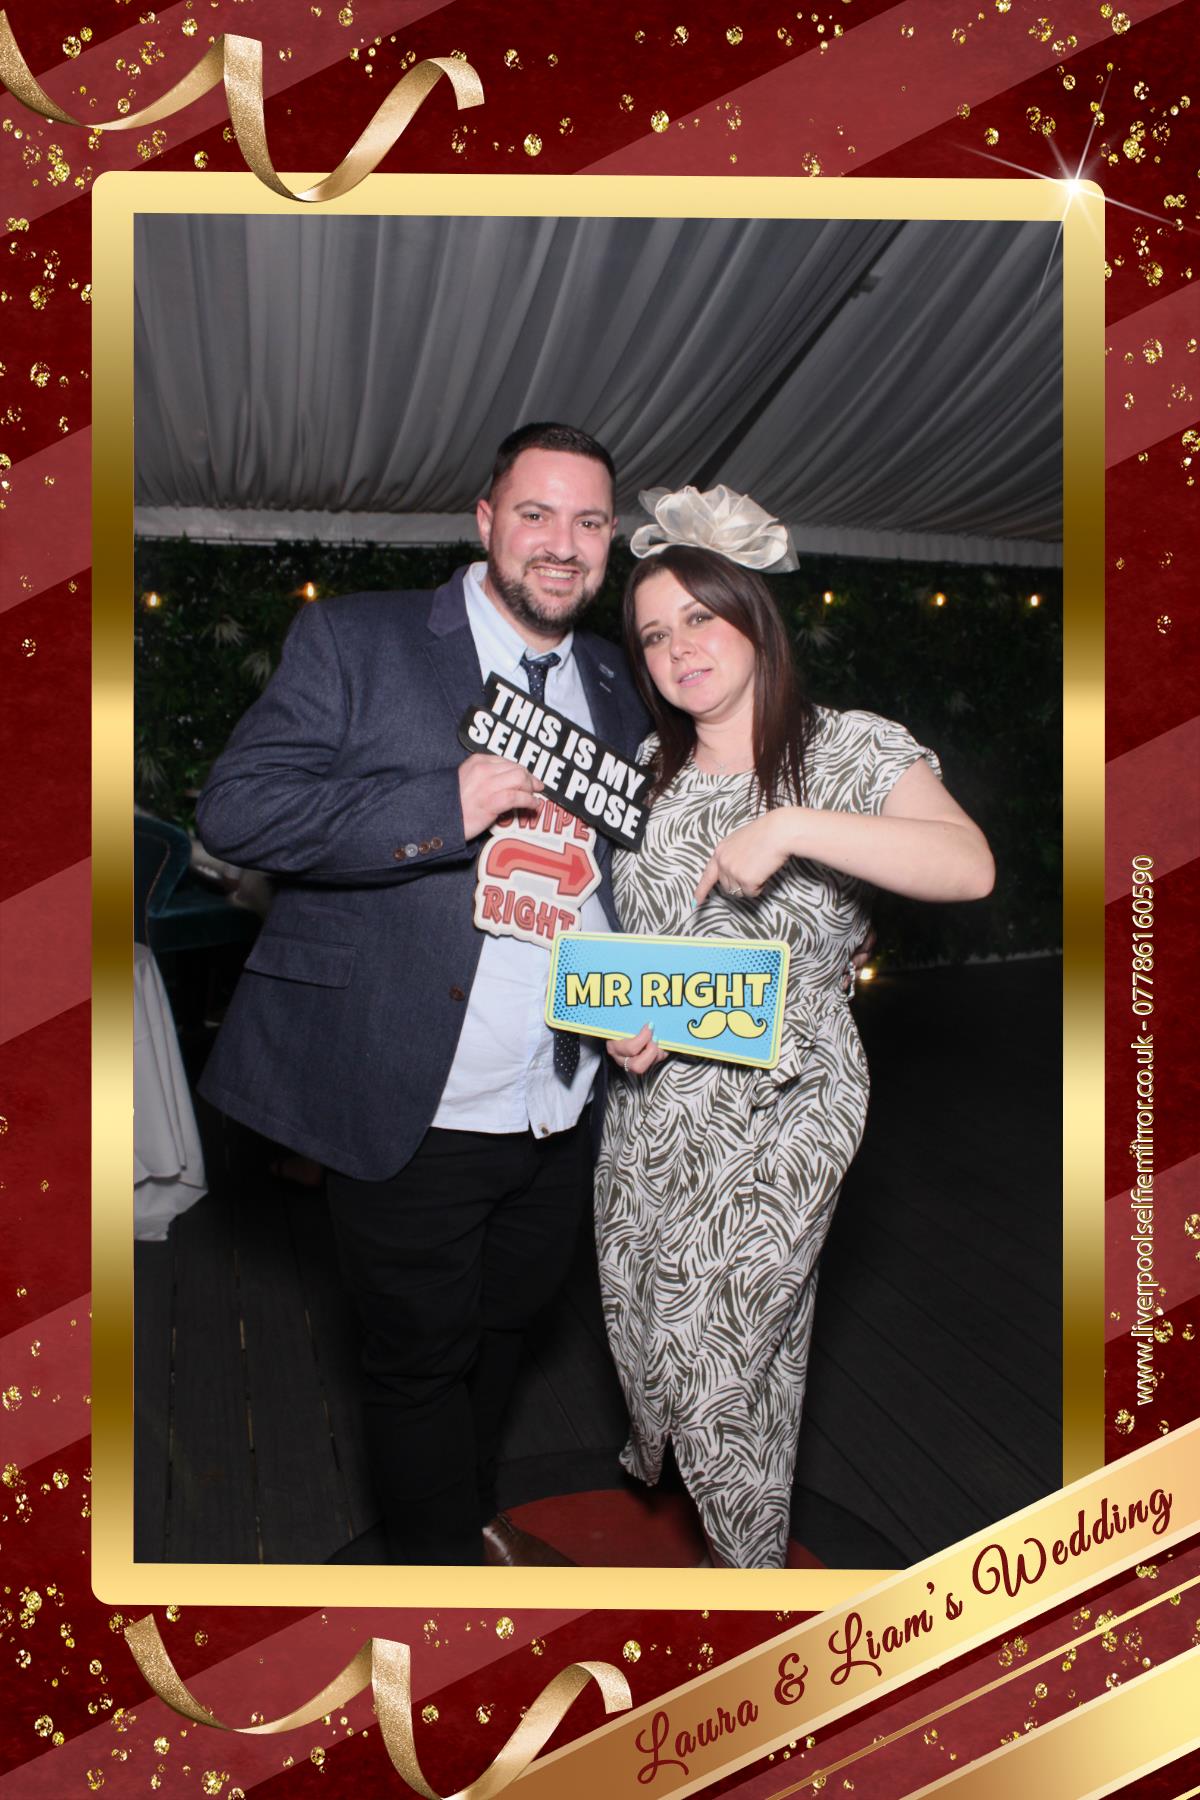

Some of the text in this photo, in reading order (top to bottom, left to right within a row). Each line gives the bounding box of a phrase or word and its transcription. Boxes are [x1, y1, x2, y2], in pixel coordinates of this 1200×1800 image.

[468, 710, 642, 840] SELFIE POSE
[490, 683, 646, 800] THIS IS MY
[482, 885, 576, 940] RIGHT
[565, 971, 772, 1008] MR RIGHT
